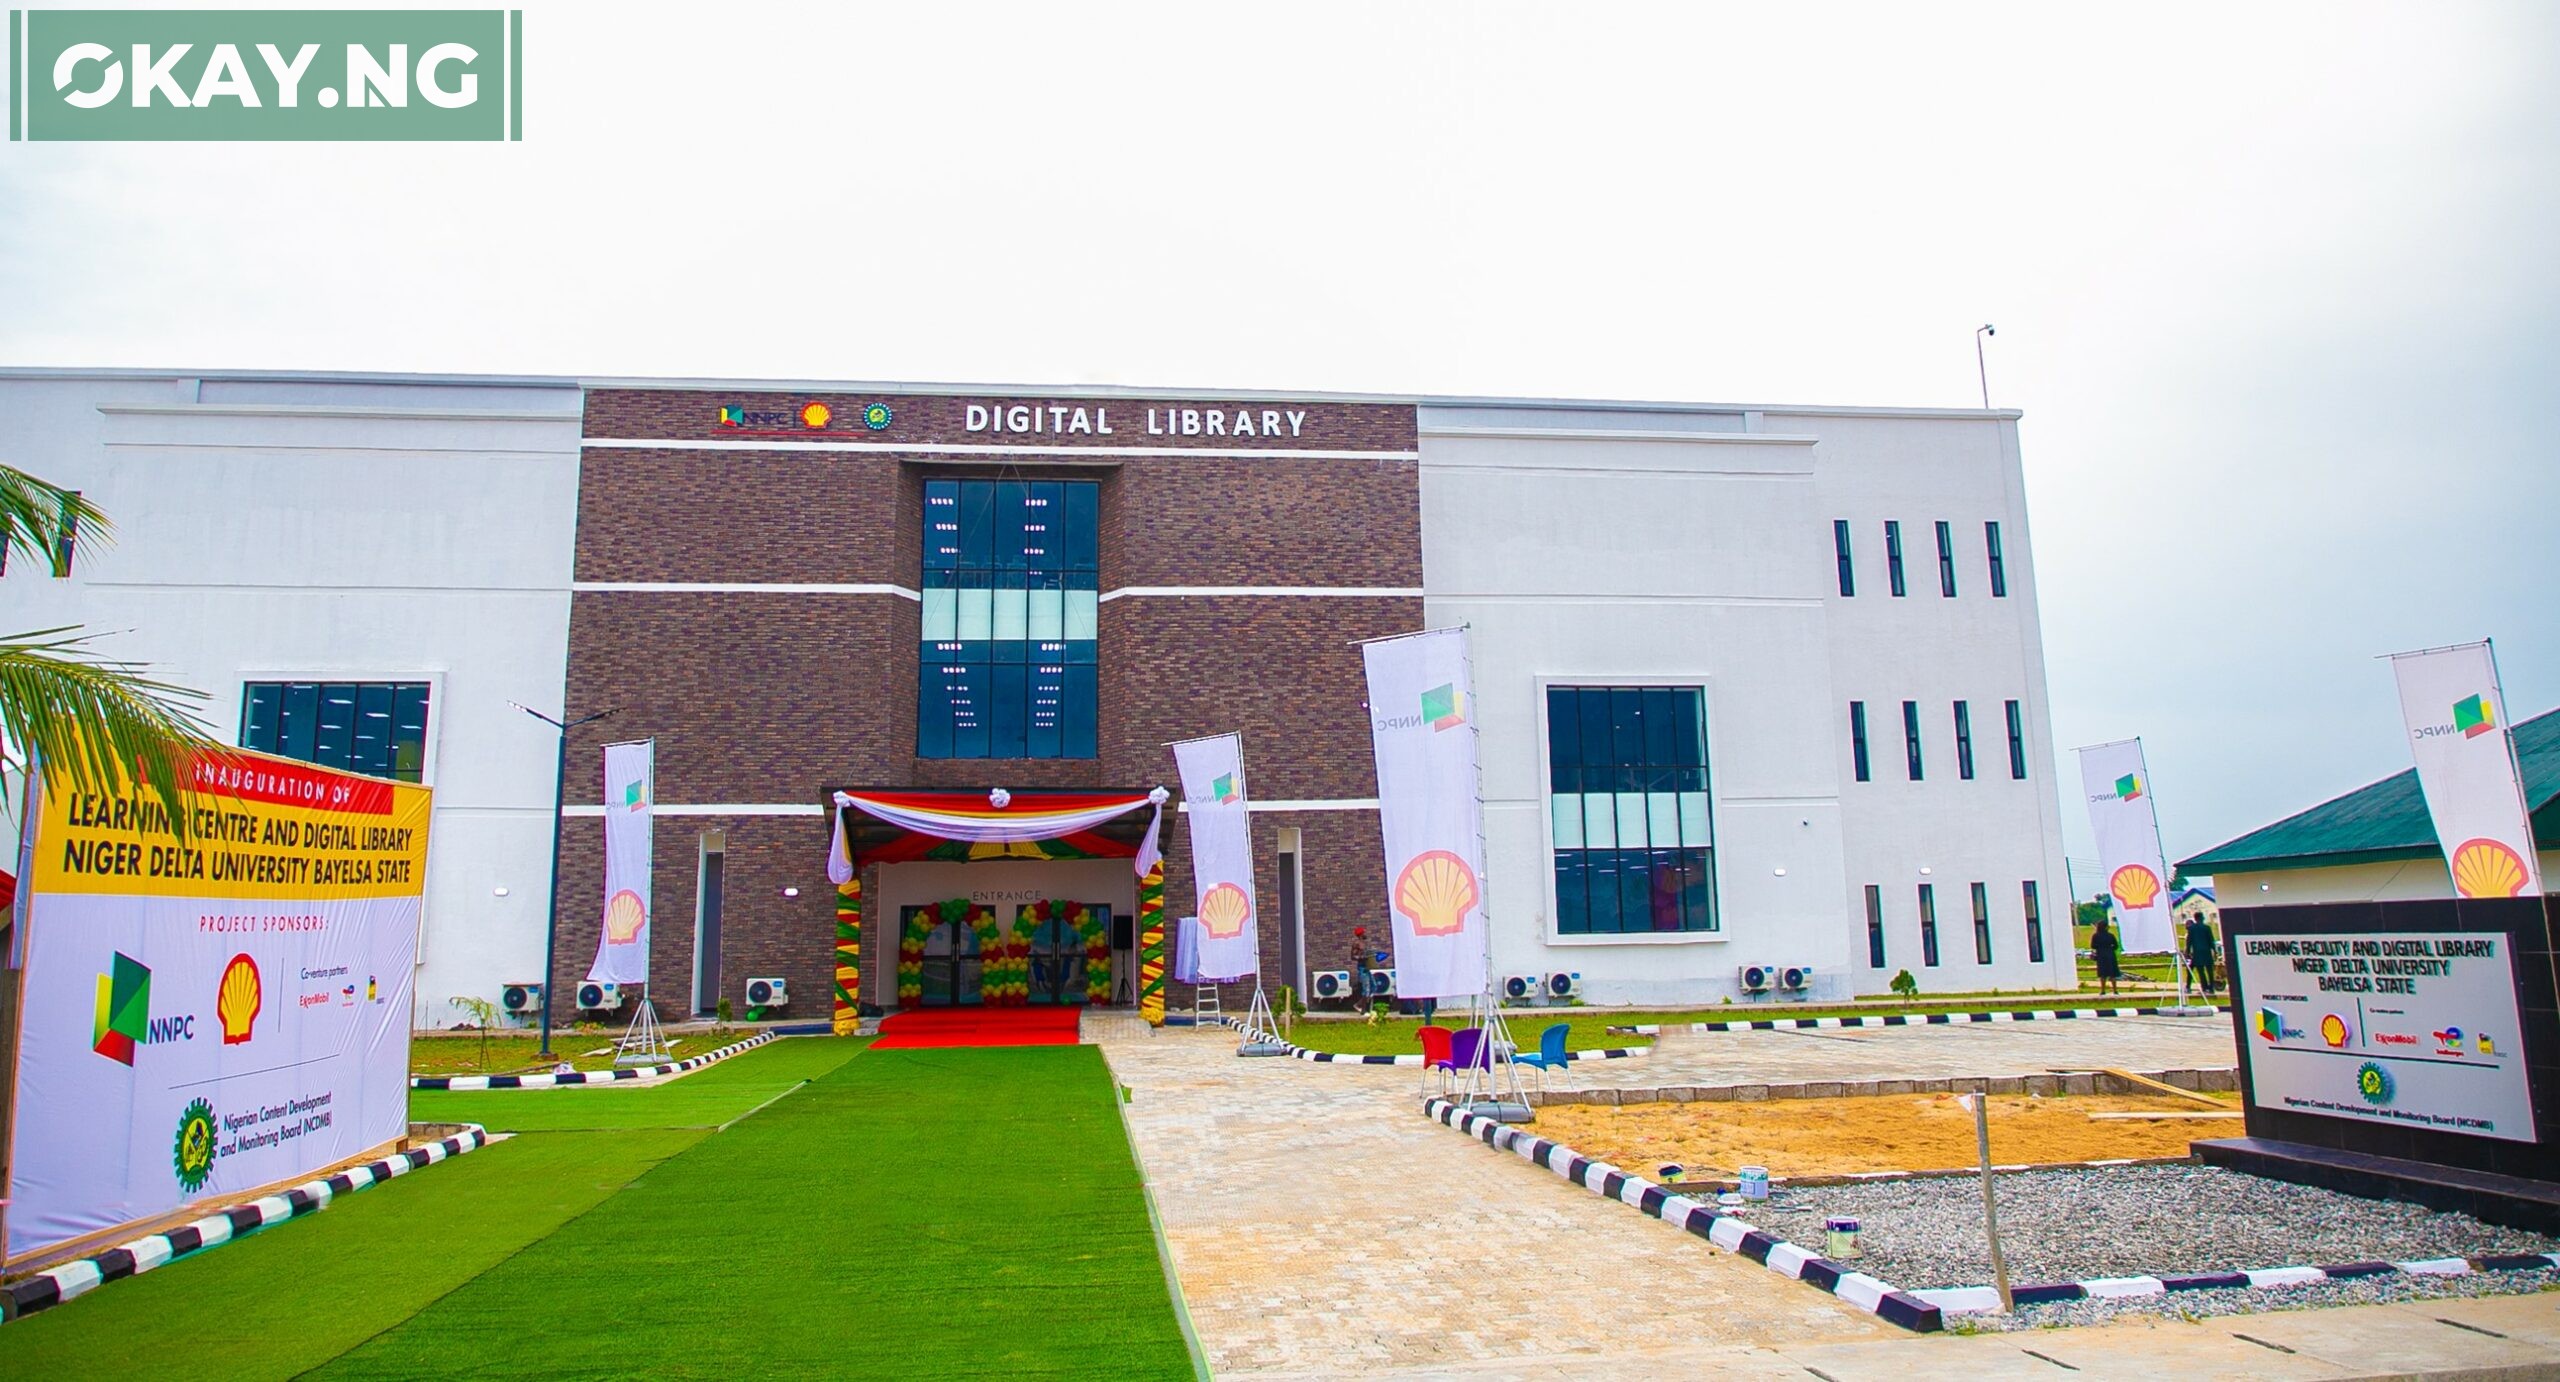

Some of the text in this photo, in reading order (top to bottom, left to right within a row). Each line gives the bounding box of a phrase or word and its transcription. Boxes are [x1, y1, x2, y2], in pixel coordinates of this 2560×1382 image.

[743, 411, 788, 425] NNPC
[965, 404, 1306, 437] DIGITAL LIBRARY
[195, 762, 351, 804] INAUGURATION OF
[68, 792, 413, 852] LEARNIN CENTRE AND DIGITAL LIBRARY
[63, 838, 411, 886] NIGER DELTA UNIVERSITY BAYELSA STATE
[972, 890, 1042, 901] ENTRANCE
[199, 915, 329, 933] PROJECT SPONSORS:
[2244, 940, 2494, 958] LEARNING FACILITY AND DIGITAL LIBRARY
[2292, 958, 2449, 977] NIGER DELTA UNIVERSITY
[2318, 976, 2416, 995] BAYELSA STATE
[149, 1014, 195, 1045] NNPC
[223, 1090, 332, 1134] Nigerian Content Development
[2310, 1099, 2335, 1110] Content
[2335, 1102, 2378, 1116] Development
[2393, 1109, 2431, 1125] Monitoring
[2432, 1114, 2456, 1126] Board
[2456, 1116, 2494, 1132] (NCDMB)
[220, 1110, 333, 1158] and Monitoring Board (NCDMB)
